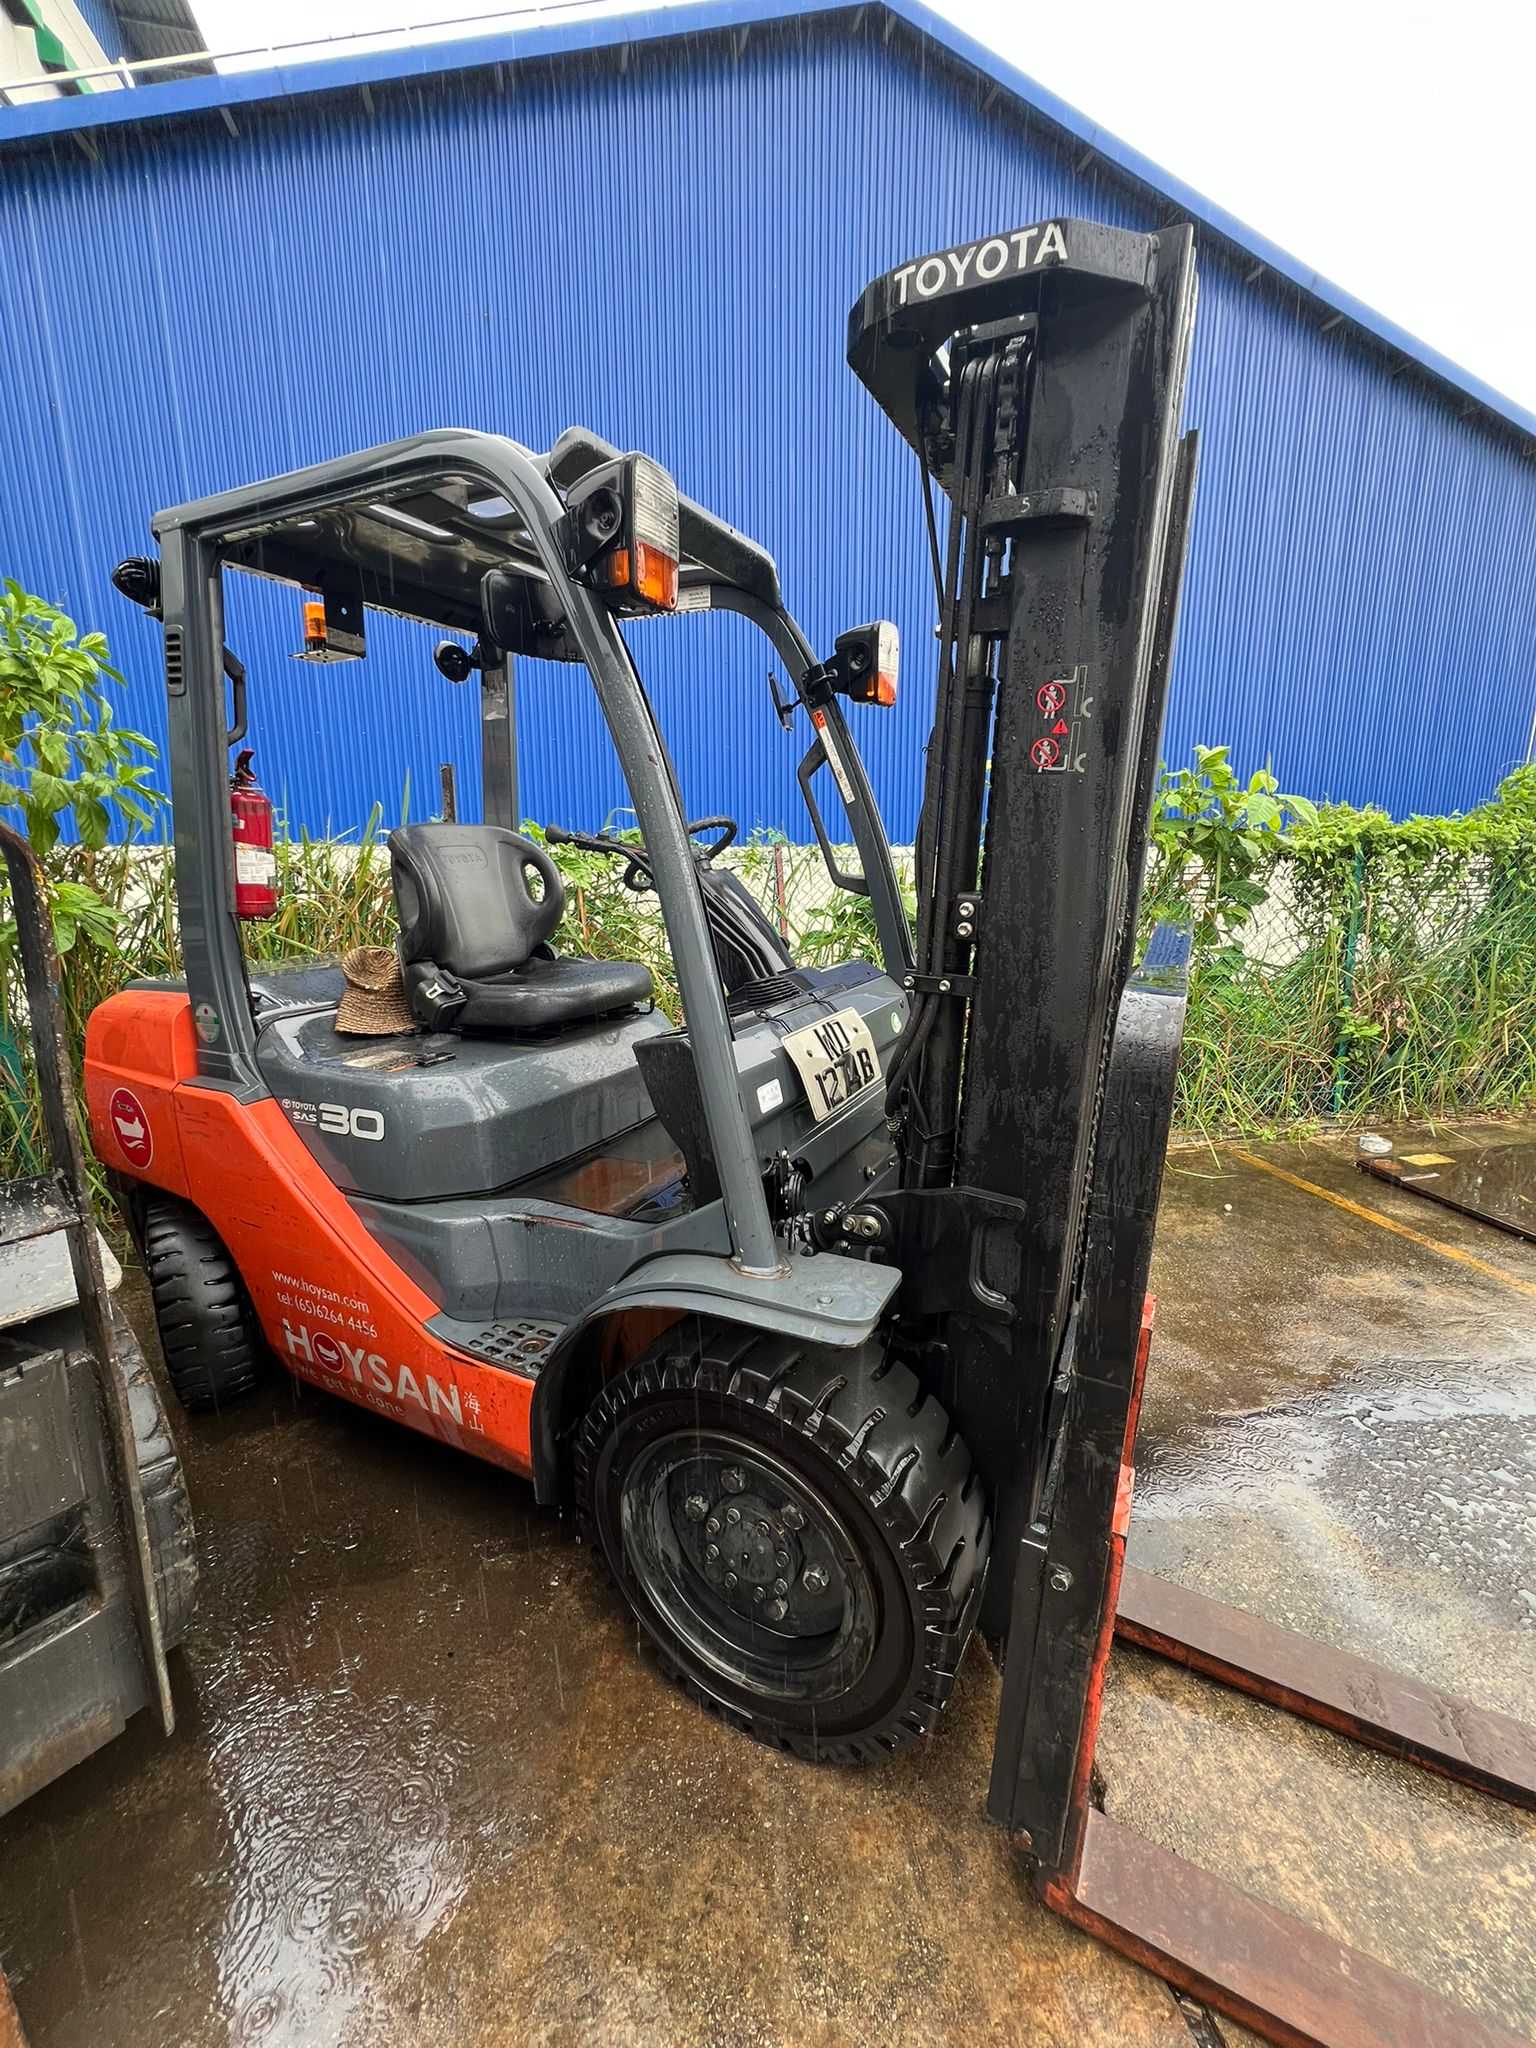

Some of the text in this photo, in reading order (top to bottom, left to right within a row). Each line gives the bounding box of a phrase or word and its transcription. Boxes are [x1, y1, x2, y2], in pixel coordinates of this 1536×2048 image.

[894, 222, 1068, 305] TOYOTA
[443, 852, 483, 866] TOYOTA
[813, 1021, 851, 1062] WD
[291, 1100, 317, 1112] TOYOTA
[292, 1102, 385, 1141] SAS 30
[272, 1270, 370, 1314] www.hoysan.com
[277, 1292, 378, 1339] tel: (65)6264 4456
[282, 1318, 464, 1426] HOYSAN
[348, 1382, 362, 1399] it
[366, 1391, 406, 1417] done
